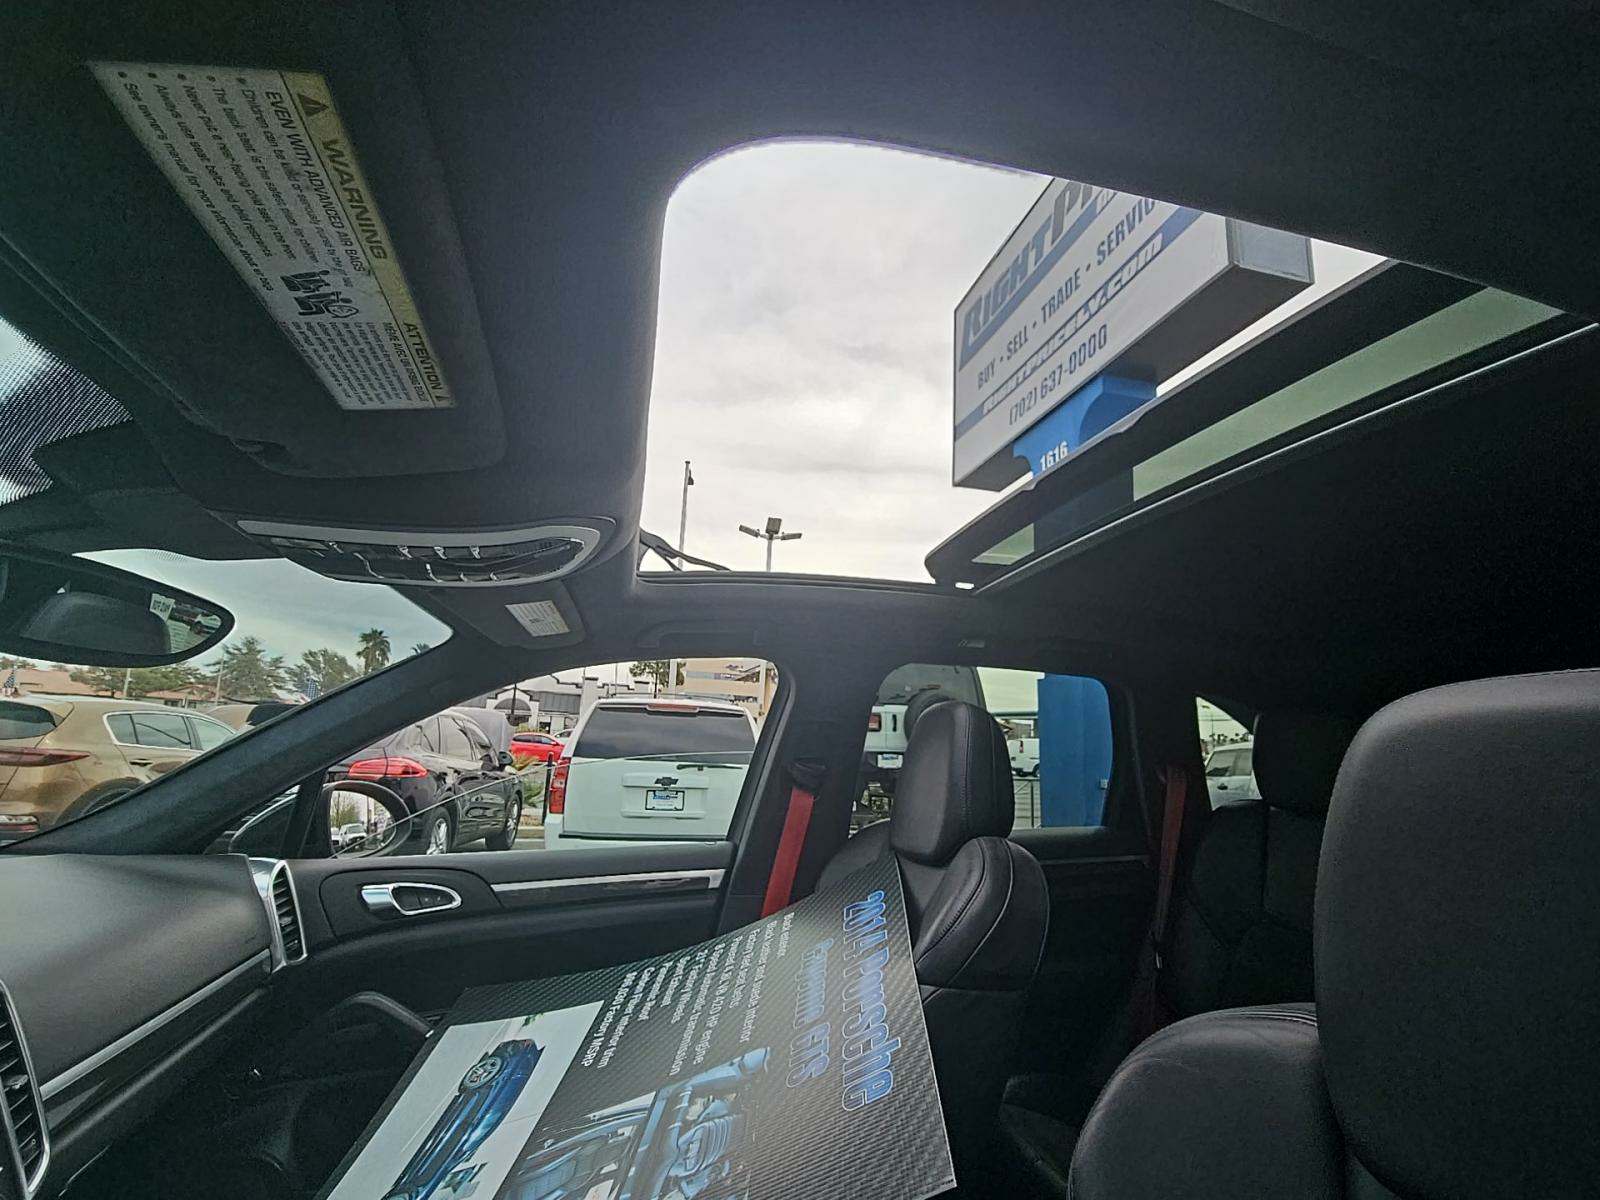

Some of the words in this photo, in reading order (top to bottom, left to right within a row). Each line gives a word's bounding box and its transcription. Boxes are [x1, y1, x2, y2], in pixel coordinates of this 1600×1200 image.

[240, 89, 271, 127] Children
[150, 84, 185, 118] Always
[189, 141, 212, 162] seat
[204, 165, 228, 186] belts
[230, 204, 251, 221] child
[180, 85, 208, 113] Never
[244, 189, 264, 205] child
[256, 207, 274, 222] seat
[210, 88, 232, 104] The
[221, 107, 244, 129] back
[235, 131, 256, 152] seat
[264, 182, 288, 206] safest
[121, 83, 147, 101] See
[162, 143, 193, 172] manual
[194, 189, 217, 208] more
[209, 210, 246, 247] information
[238, 249, 259, 266] about
[264, 91, 296, 128] EVEN
[285, 134, 314, 166] WITH
[304, 170, 344, 228] ADVANCED
[335, 231, 353, 245] AIR
[344, 249, 365, 271] BAGS
[319, 139, 389, 259] WARNING
[977, 359, 998, 392] BUY
[1005, 333, 1029, 363] SELL
[1041, 270, 1082, 325] TRADE
[1096, 196, 1157, 267] SERVIC
[402, 322, 443, 389] ATTENTION
[1009, 389, 1038, 427] (702)
[1040, 324, 1108, 398] 637-0000
[1039, 440, 1069, 473] 1616
[764, 920, 776, 940] Black
[781, 912, 794, 932] Black
[842, 889, 888, 960] 2014
[723, 935, 742, 966] Powered
[743, 928, 759, 954] Factory
[673, 955, 690, 976] Sport
[706, 948, 723, 972] Speed
[740, 953, 752, 969] Red
[753, 964, 766, 981] and
[633, 966, 654, 994] Carbon
[645, 961, 672, 1001] Panoramic
[659, 975, 681, 1007] Exhaust
[680, 963, 702, 992] Factory
[692, 971, 715, 1012] Automatic
[715, 982, 729, 995] V8
[735, 968, 747, 986] seat
[623, 992, 642, 1015] Fiber
[637, 999, 656, 1022] Roof
[670, 991, 691, 1024] Wheels
[708, 994, 725, 1014] 420
[729, 984, 745, 1009] belts
[747, 980, 761, 1008] suede
[593, 1004, 620, 1038] Factory
[607, 1014, 631, 1047] interior
[704, 1012, 720, 1028] HP
[738, 1006, 758, 1043] interior
[842, 947, 903, 1113] Porsche
[580, 1036, 604, 1068] MSRP
[596, 1046, 616, 1068] trim
[669, 1011, 701, 1075] transmission
[693, 1028, 712, 1065] engine
[785, 1021, 829, 1089] GTS
